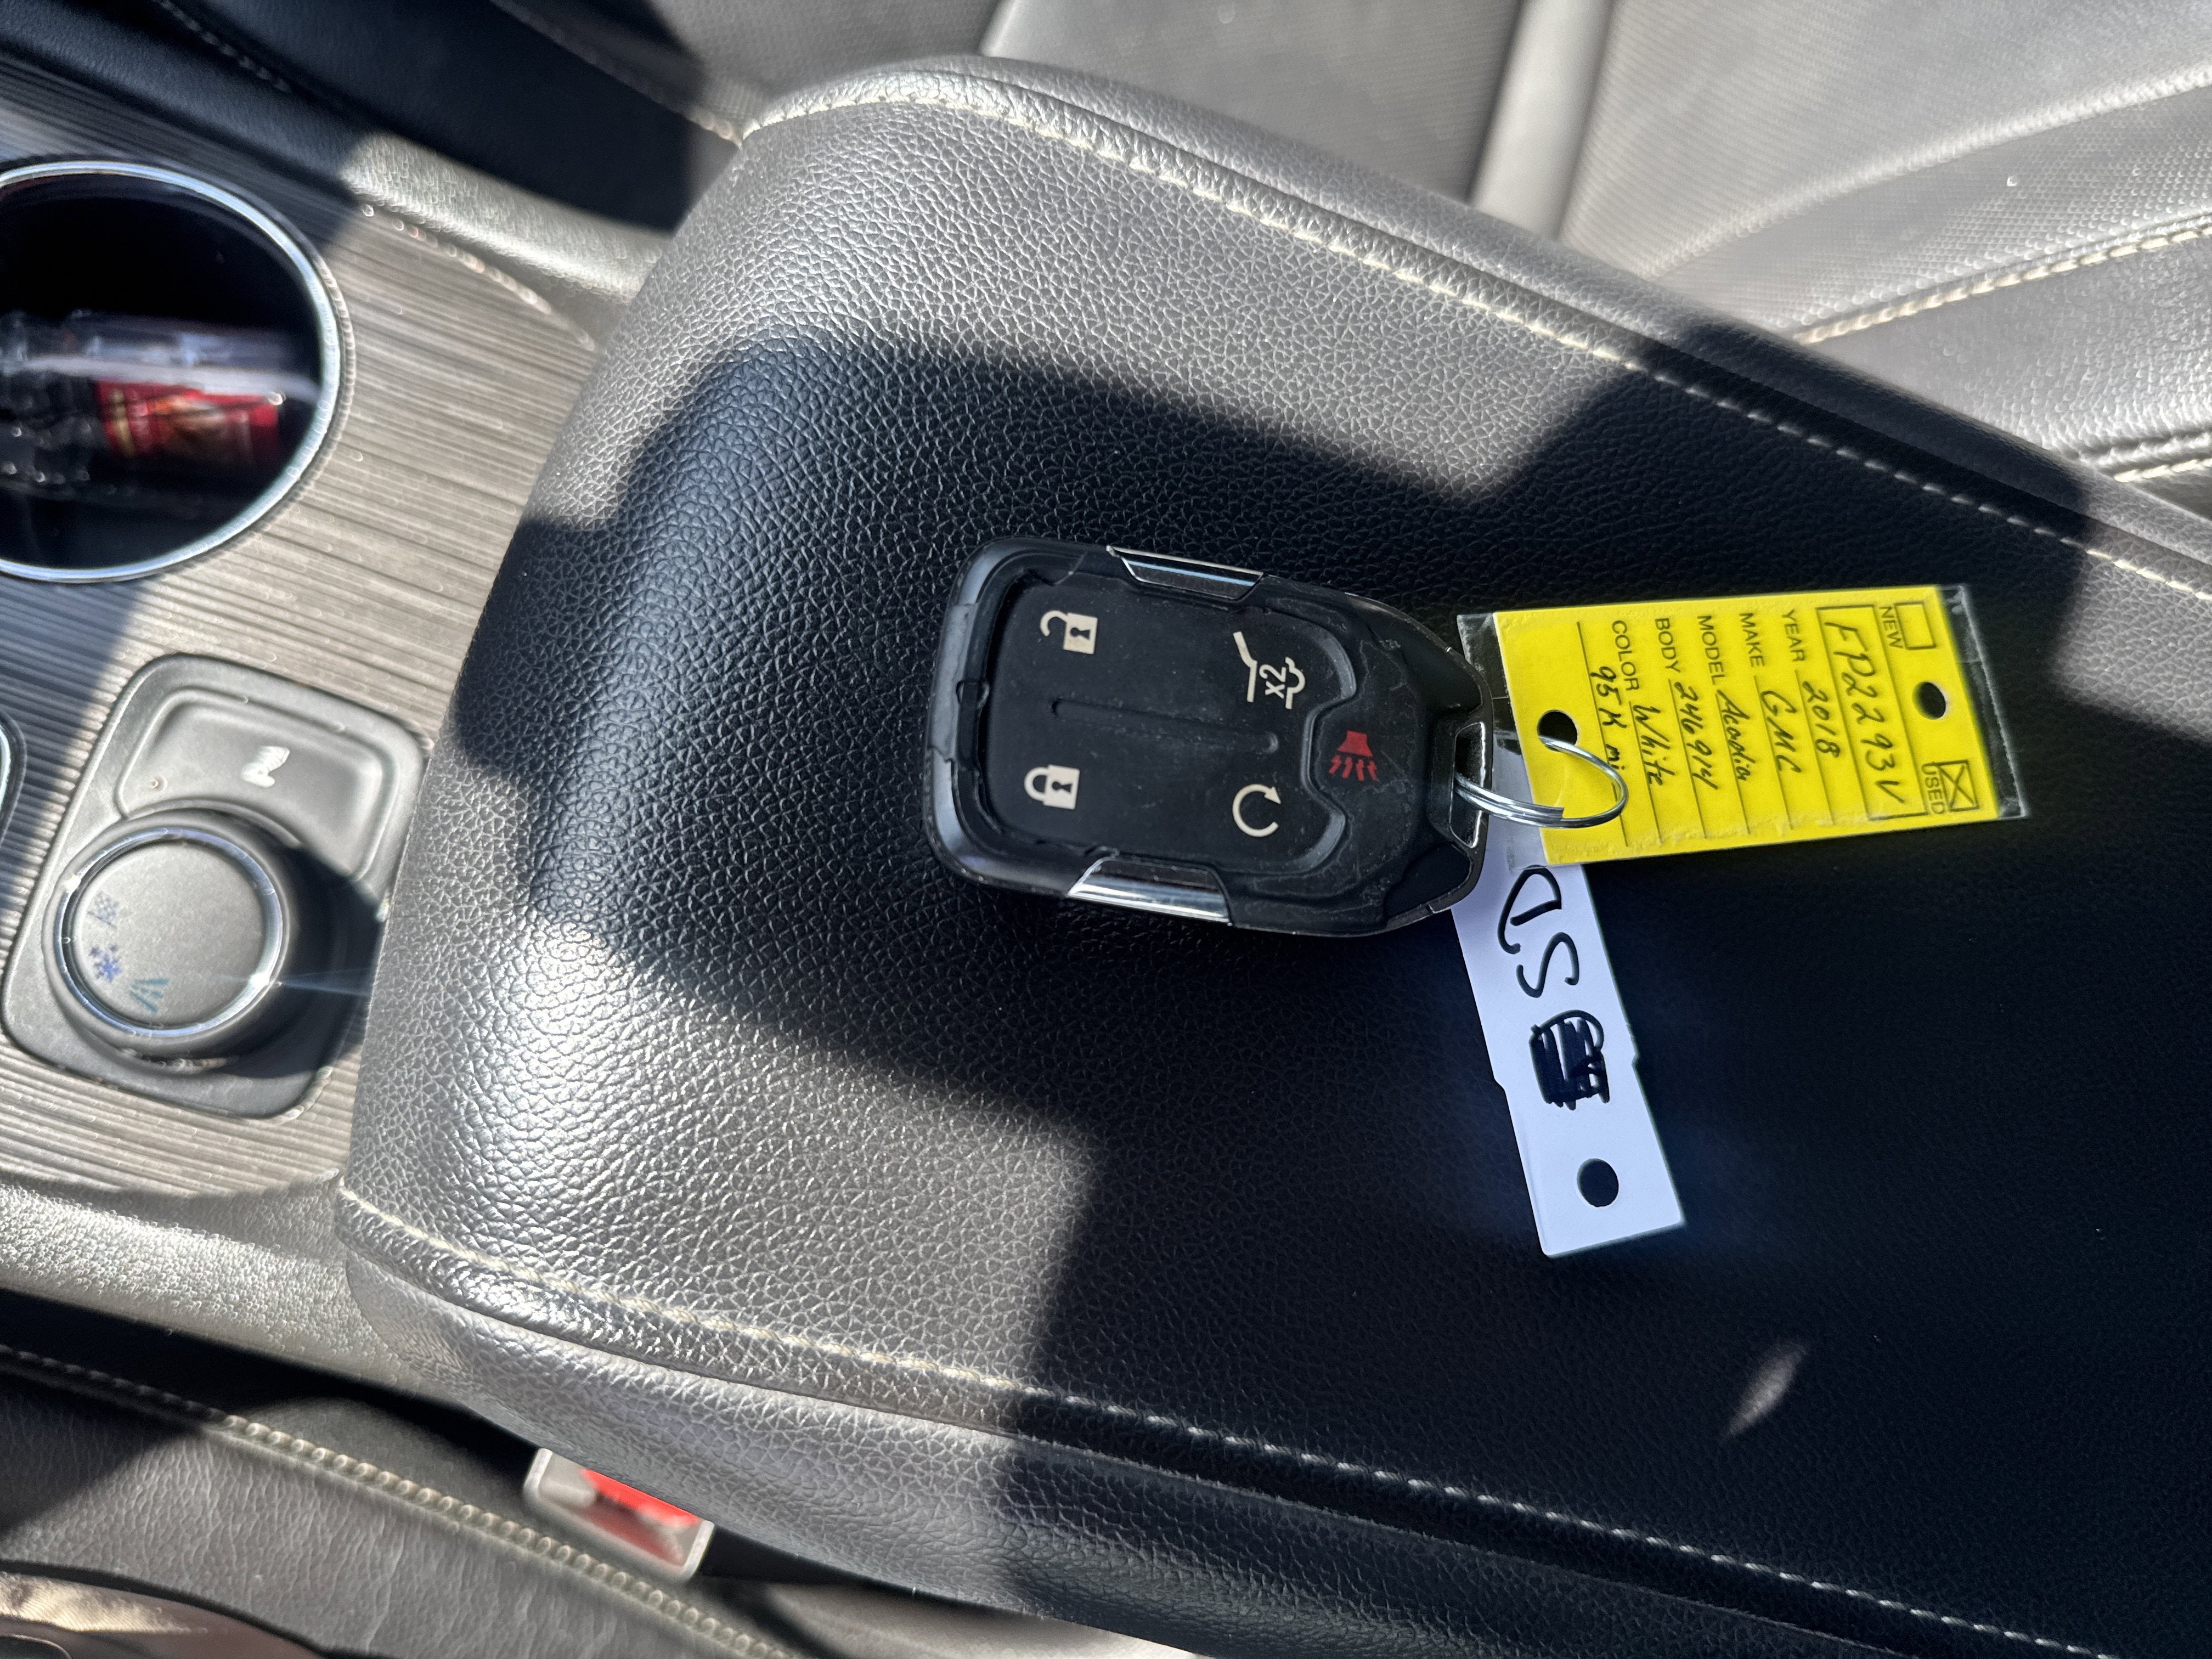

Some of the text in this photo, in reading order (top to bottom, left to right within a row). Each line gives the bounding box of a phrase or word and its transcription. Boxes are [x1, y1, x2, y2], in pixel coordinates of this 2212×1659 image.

[1611, 620, 1640, 691] COLOR
[1655, 617, 1681, 673] BODY
[1697, 615, 1725, 686] MODEL
[1739, 612, 1765, 668] MAKE
[1782, 609, 1805, 662] YEAR
[1879, 605, 1903, 649] NEW
[1633, 704, 1675, 786] White
[1716, 689, 1756, 781] Acadia
[1760, 690, 1802, 774] GMC
[1803, 681, 1841, 758] 2018
[1824, 622, 1905, 804] FP2293V
[1922, 764, 1945, 815] USED
